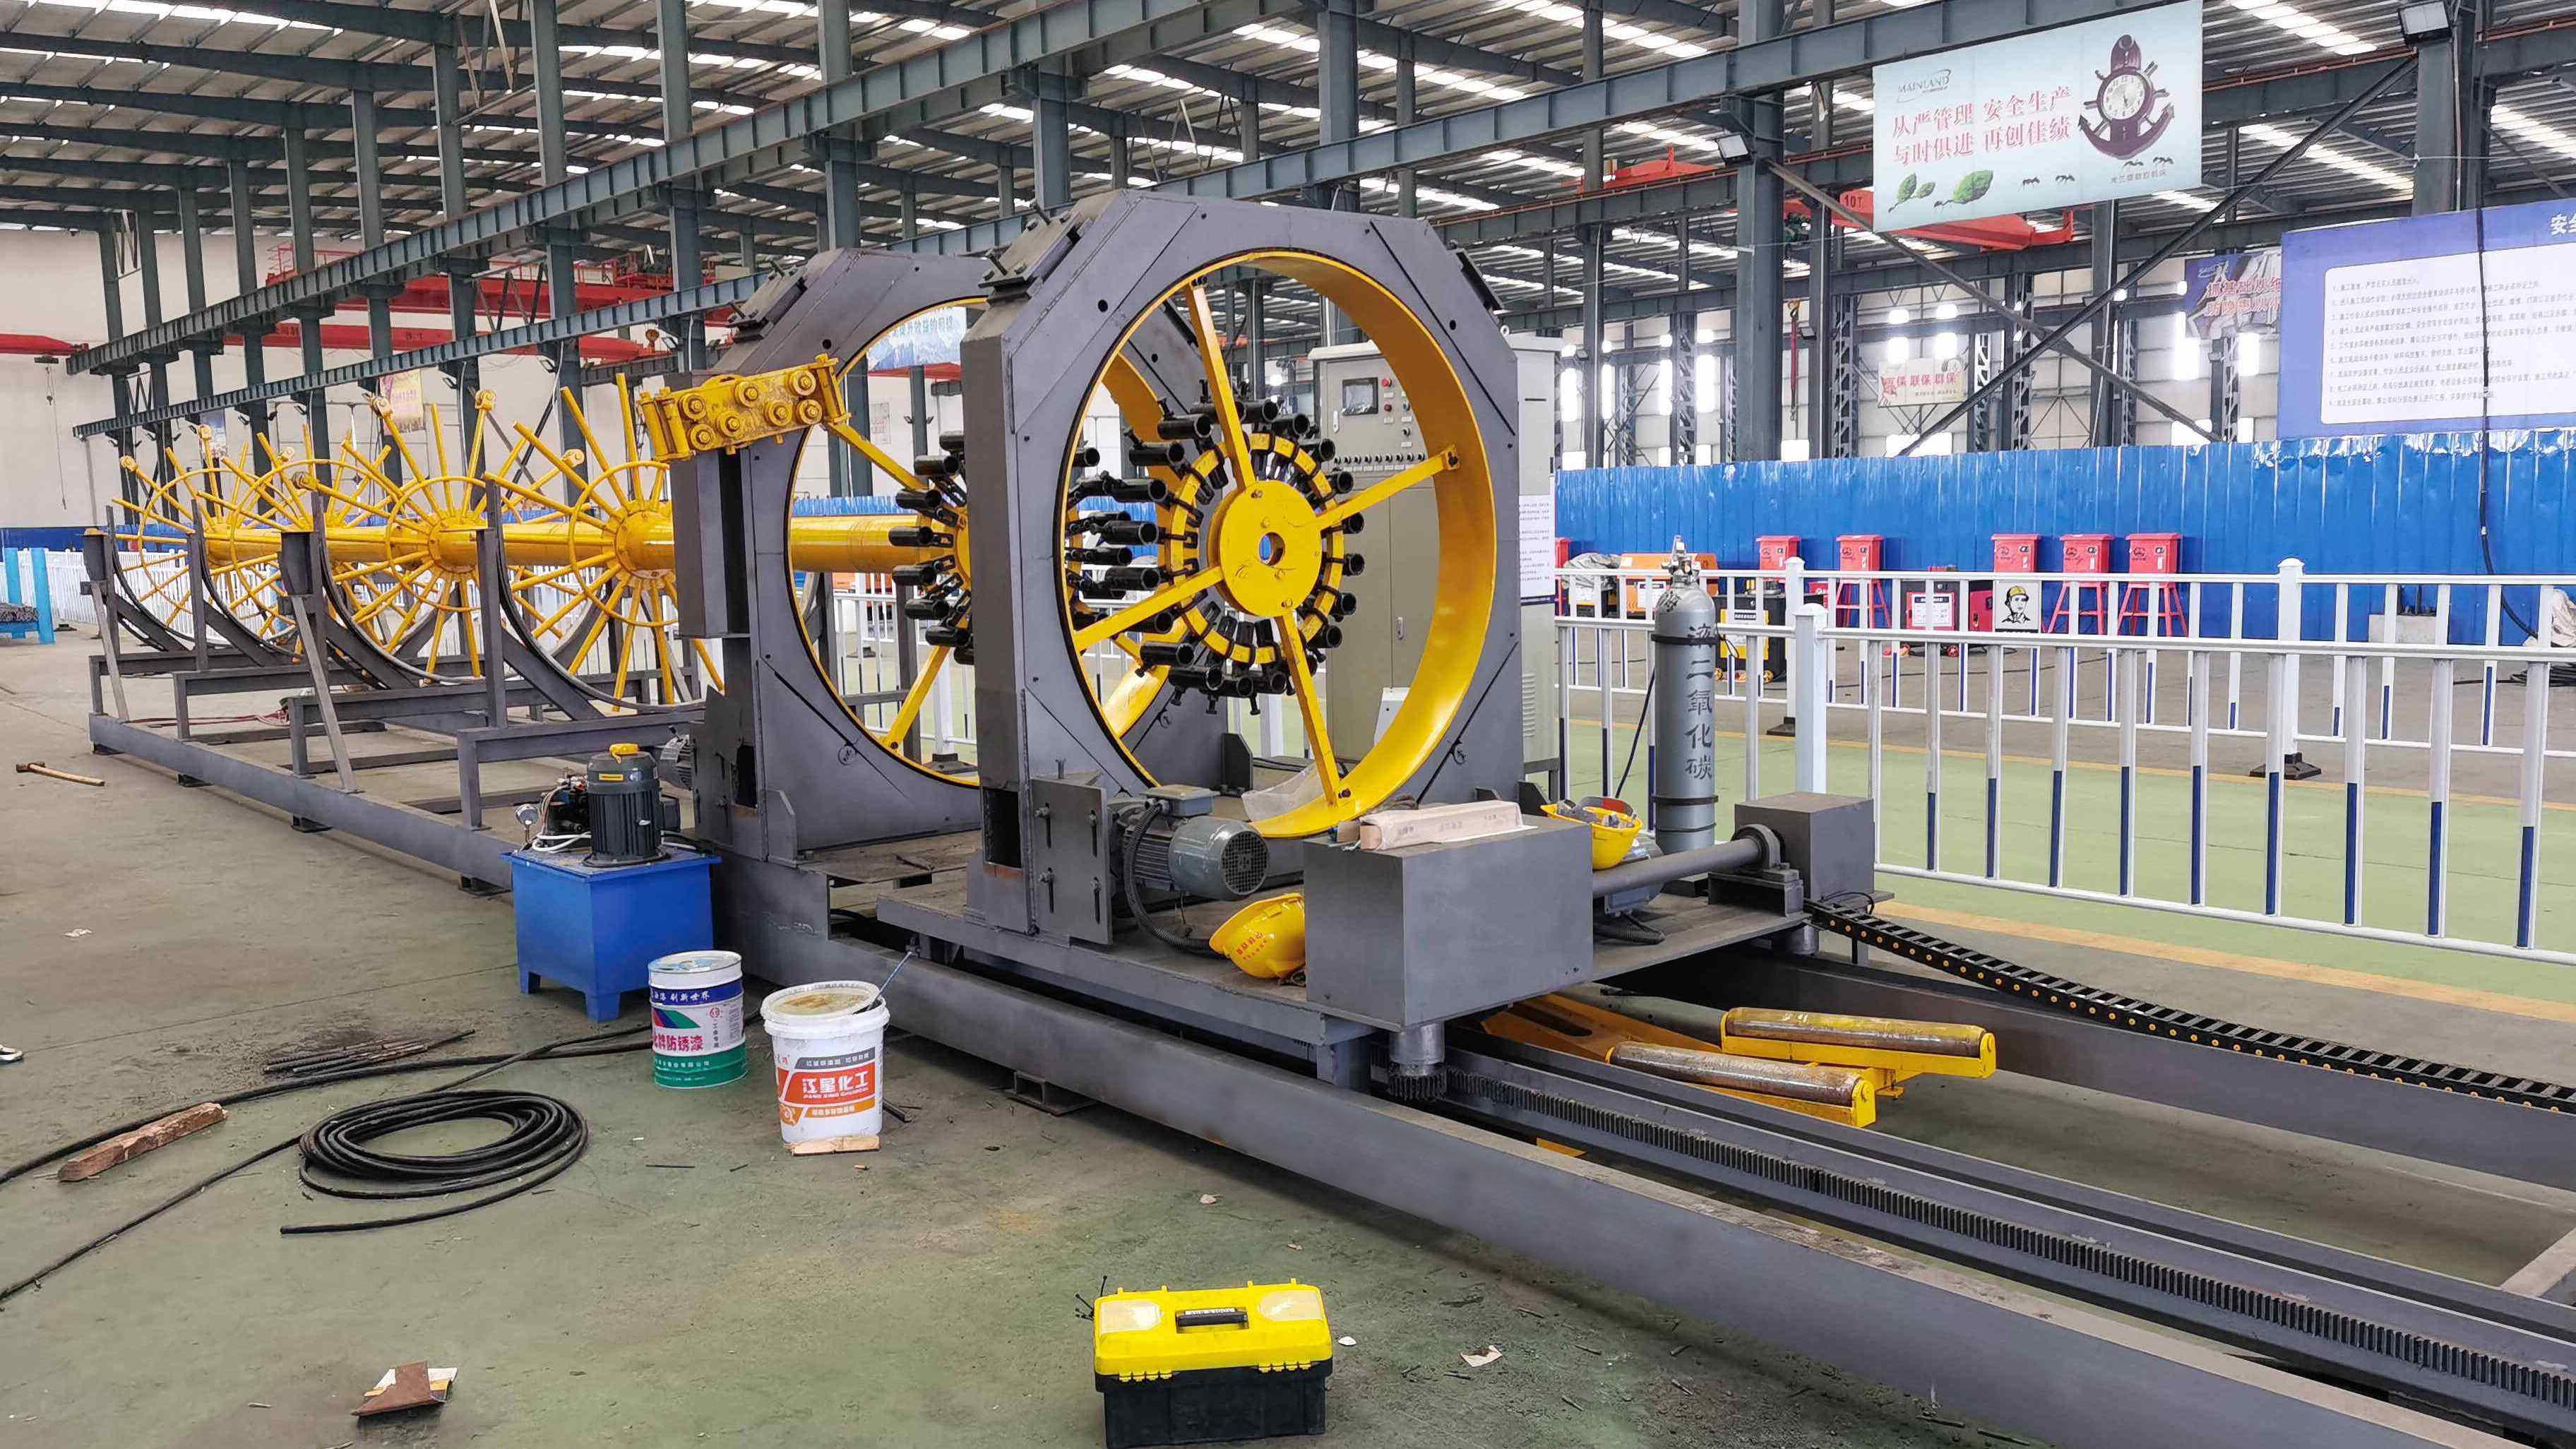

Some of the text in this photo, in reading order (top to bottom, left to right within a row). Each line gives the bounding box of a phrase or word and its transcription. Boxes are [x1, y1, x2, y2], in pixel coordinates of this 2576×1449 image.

[1892, 85, 2071, 139] 从严管理 安全生产
[1893, 114, 2070, 167] 与时俱进 再创佳绩
[801, 1071, 869, 1095] 江星化工
